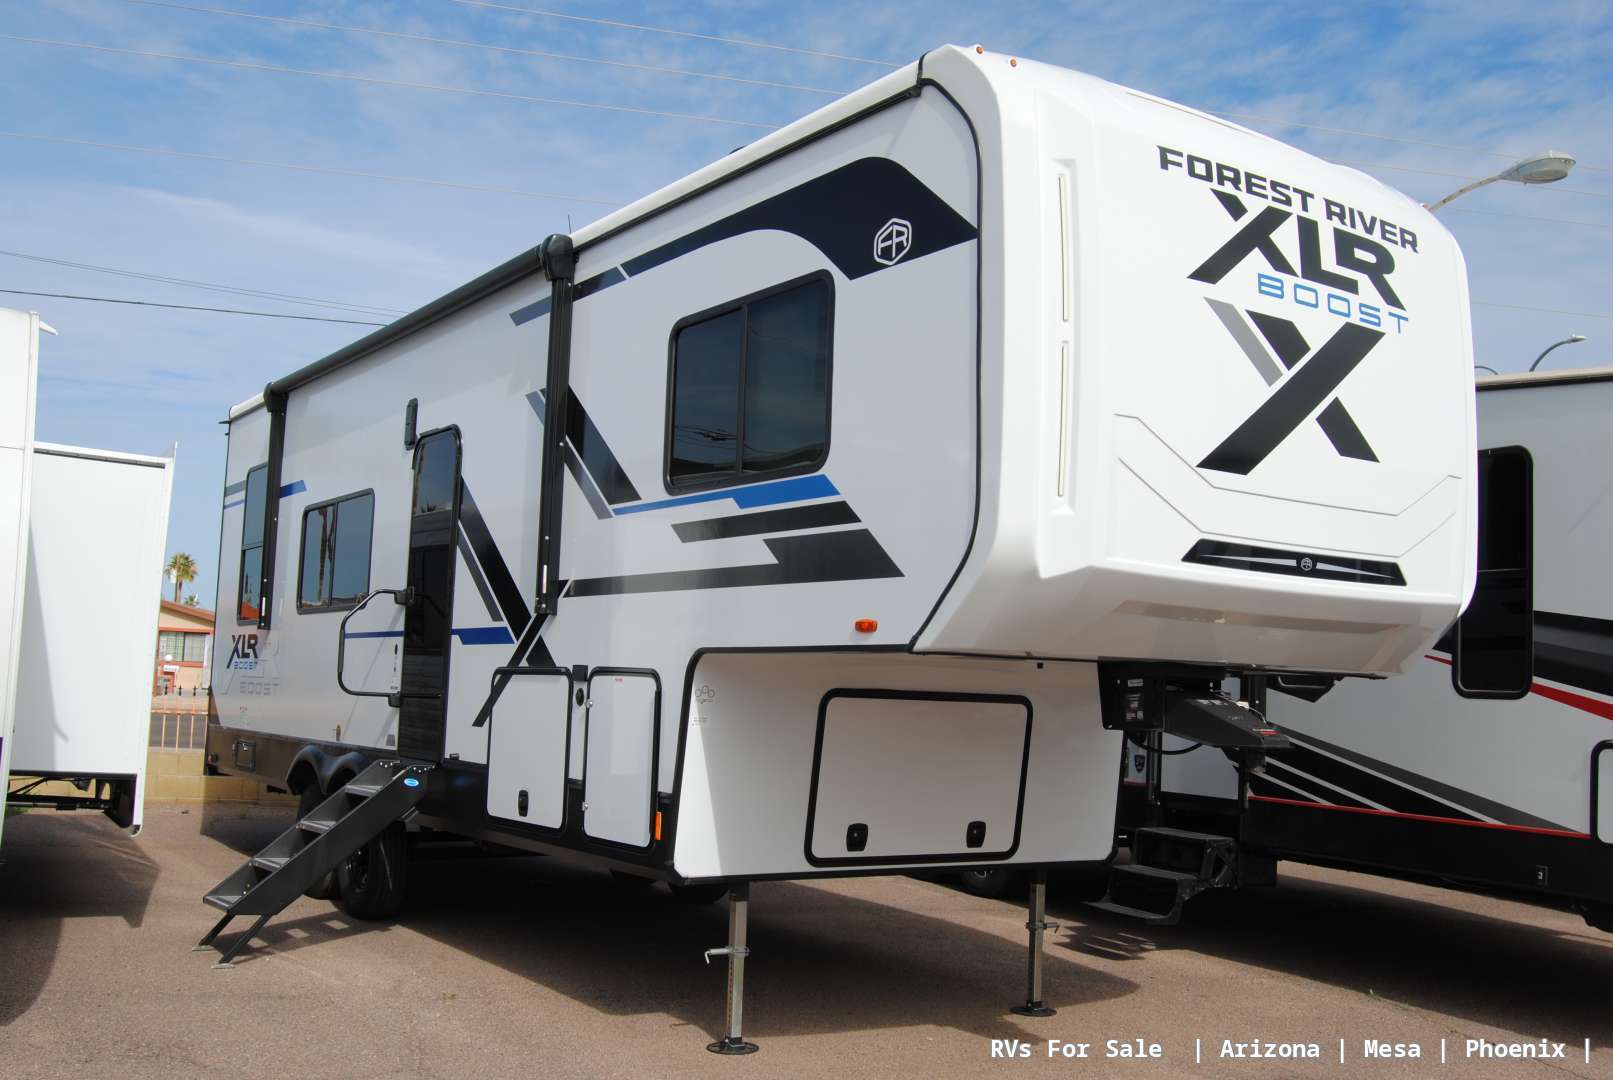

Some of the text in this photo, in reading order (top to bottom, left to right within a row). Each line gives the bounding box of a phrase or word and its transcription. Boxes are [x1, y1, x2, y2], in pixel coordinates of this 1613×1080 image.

[1156, 144, 1419, 254] FOREST RIVER
[1186, 187, 1407, 312] XLR
[1257, 272, 1409, 334] BOOST
[226, 633, 259, 669] XLR
